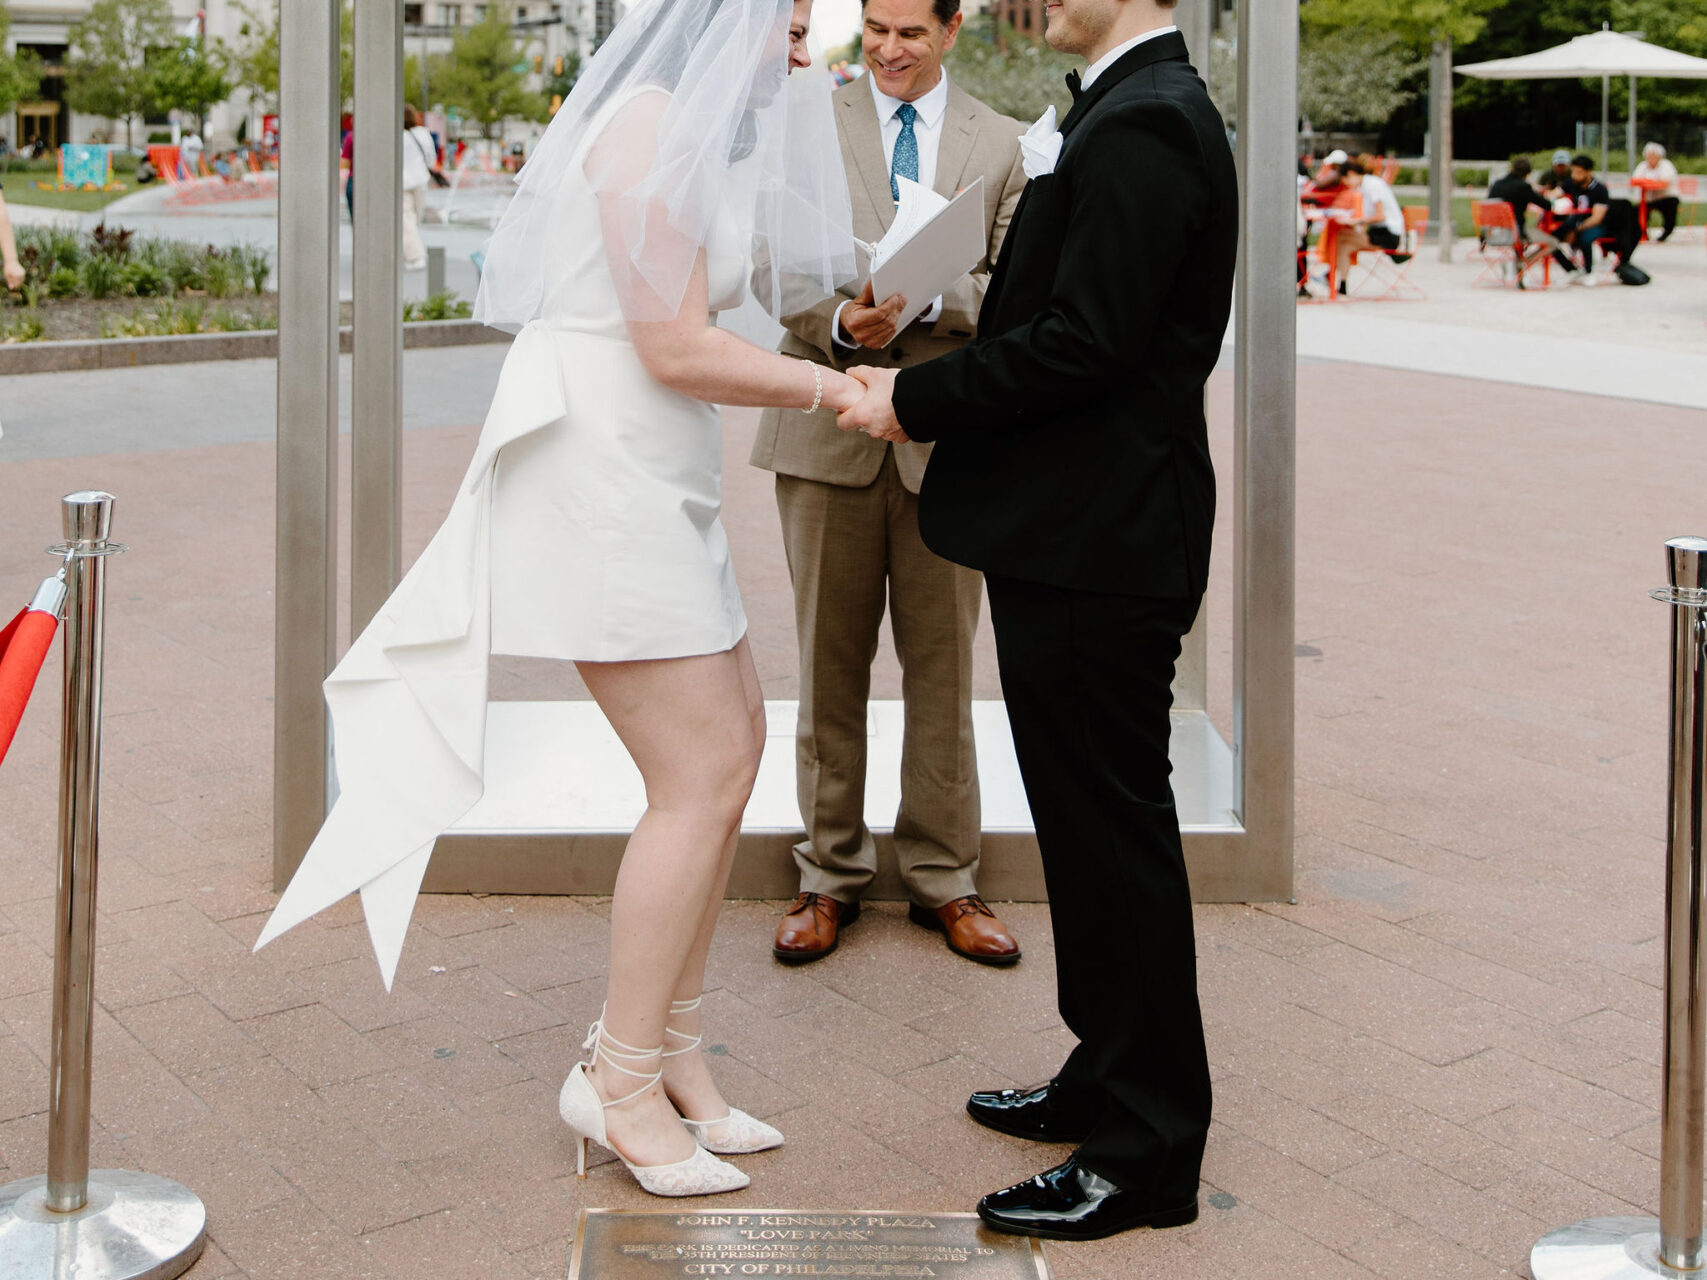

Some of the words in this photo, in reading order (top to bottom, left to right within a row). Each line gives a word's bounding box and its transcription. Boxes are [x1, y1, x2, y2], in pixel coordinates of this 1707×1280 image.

[677, 1216, 731, 1226] JOHN
[737, 1216, 754, 1226] F.
[760, 1216, 860, 1227] KENNEDY
[867, 1217, 936, 1229] PLAZA
[740, 1230, 804, 1240] "LOVE
[809, 1230, 874, 1241] PARK"
[803, 1244, 822, 1252] AS
[840, 1245, 889, 1253] LIVING
[893, 1245, 971, 1254] MEMORIAL
[974, 1247, 994, 1255] TO
[683, 1251, 717, 1259] 35TH
[720, 1251, 797, 1259] PRESIDENT
[915, 1253, 968, 1261] STATES
[684, 1263, 736, 1274] CITY
[741, 1263, 769, 1274] OF
[775, 1264, 937, 1276] PHILADELPHIA
